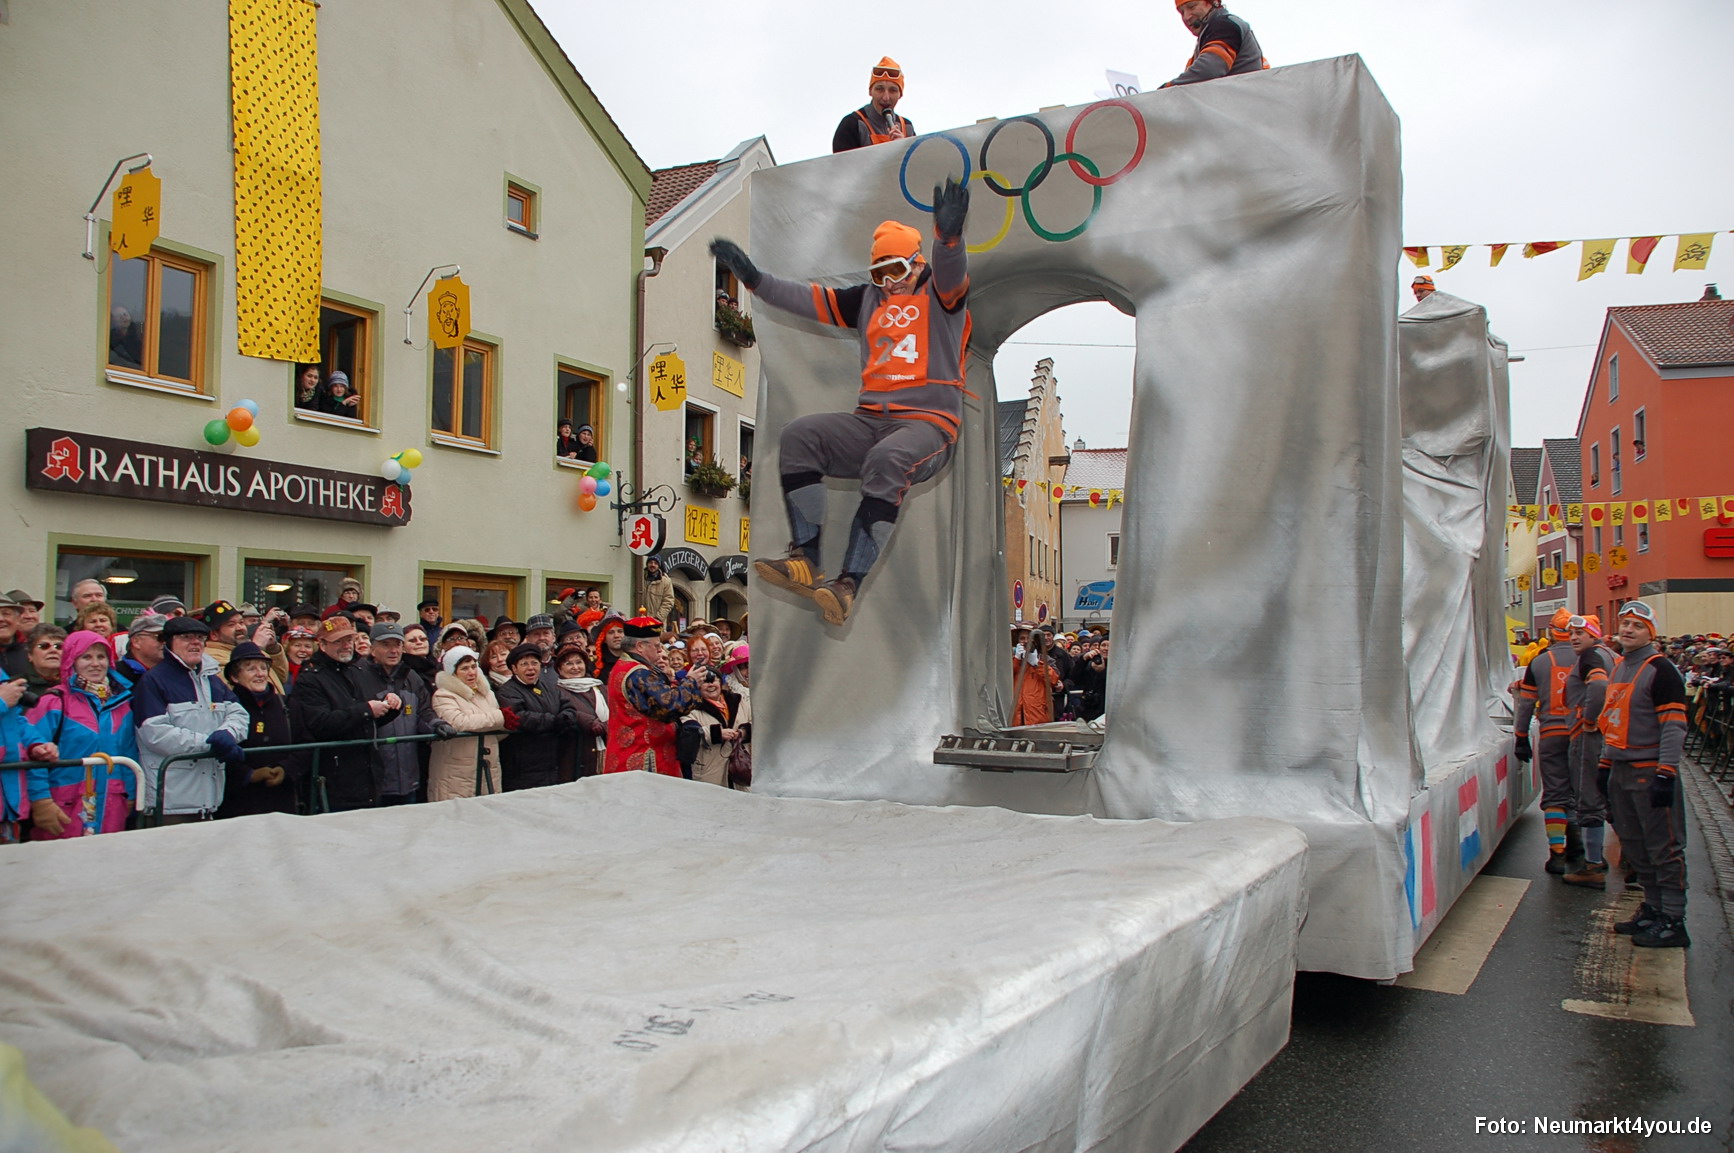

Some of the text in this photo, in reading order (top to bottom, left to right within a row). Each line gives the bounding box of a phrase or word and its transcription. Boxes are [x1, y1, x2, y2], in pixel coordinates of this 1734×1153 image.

[874, 334, 919, 366] 24
[89, 447, 377, 512] RATHAUS APOTHEKE
[664, 551, 708, 576] METZGEREI
